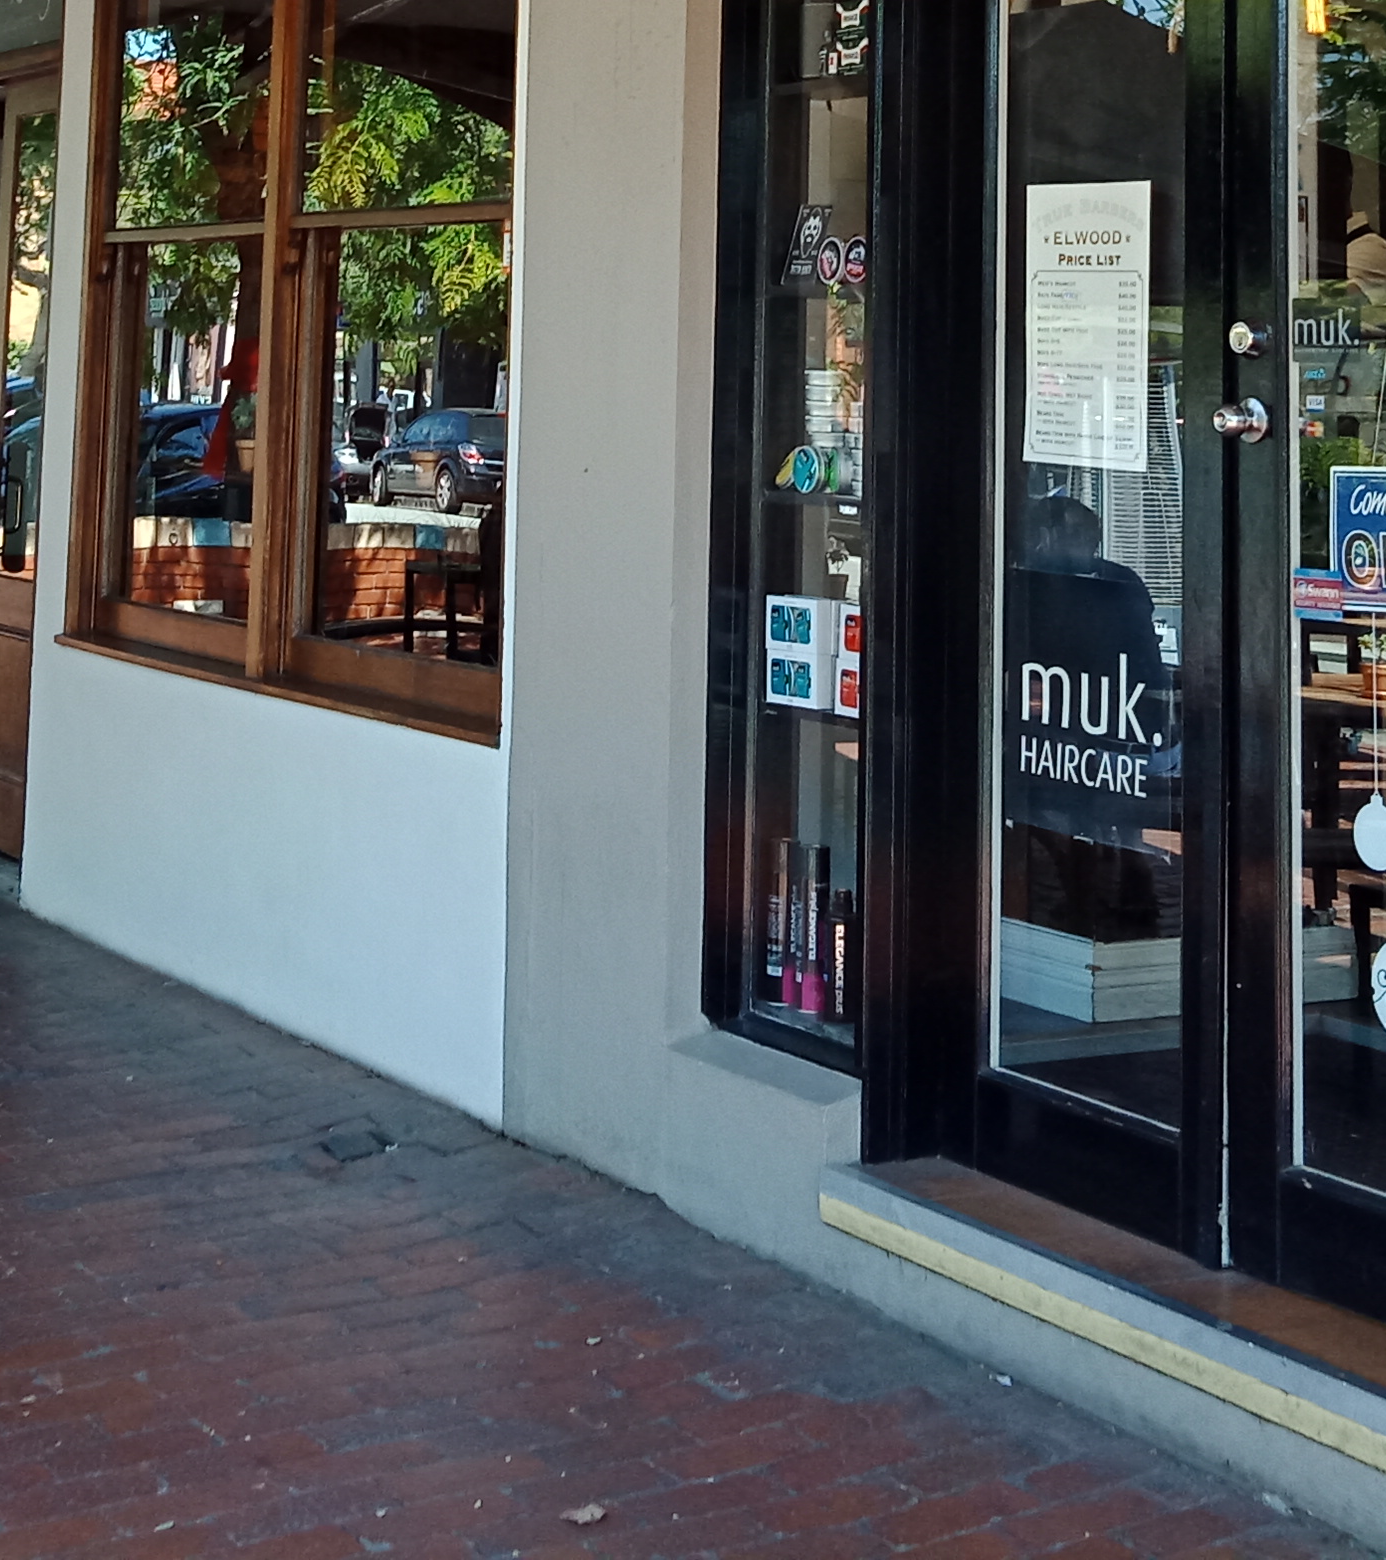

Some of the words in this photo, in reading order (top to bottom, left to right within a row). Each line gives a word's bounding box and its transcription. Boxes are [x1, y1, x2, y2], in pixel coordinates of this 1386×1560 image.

[1053, 230, 1122, 245] ELWOOD
[1058, 253, 1092, 265] PRICE
[1096, 254, 1121, 266] LIST
[1021, 652, 1163, 747] muk.
[1020, 735, 1148, 798] HAIRCARE
[835, 924, 845, 988] ELEGANCE
